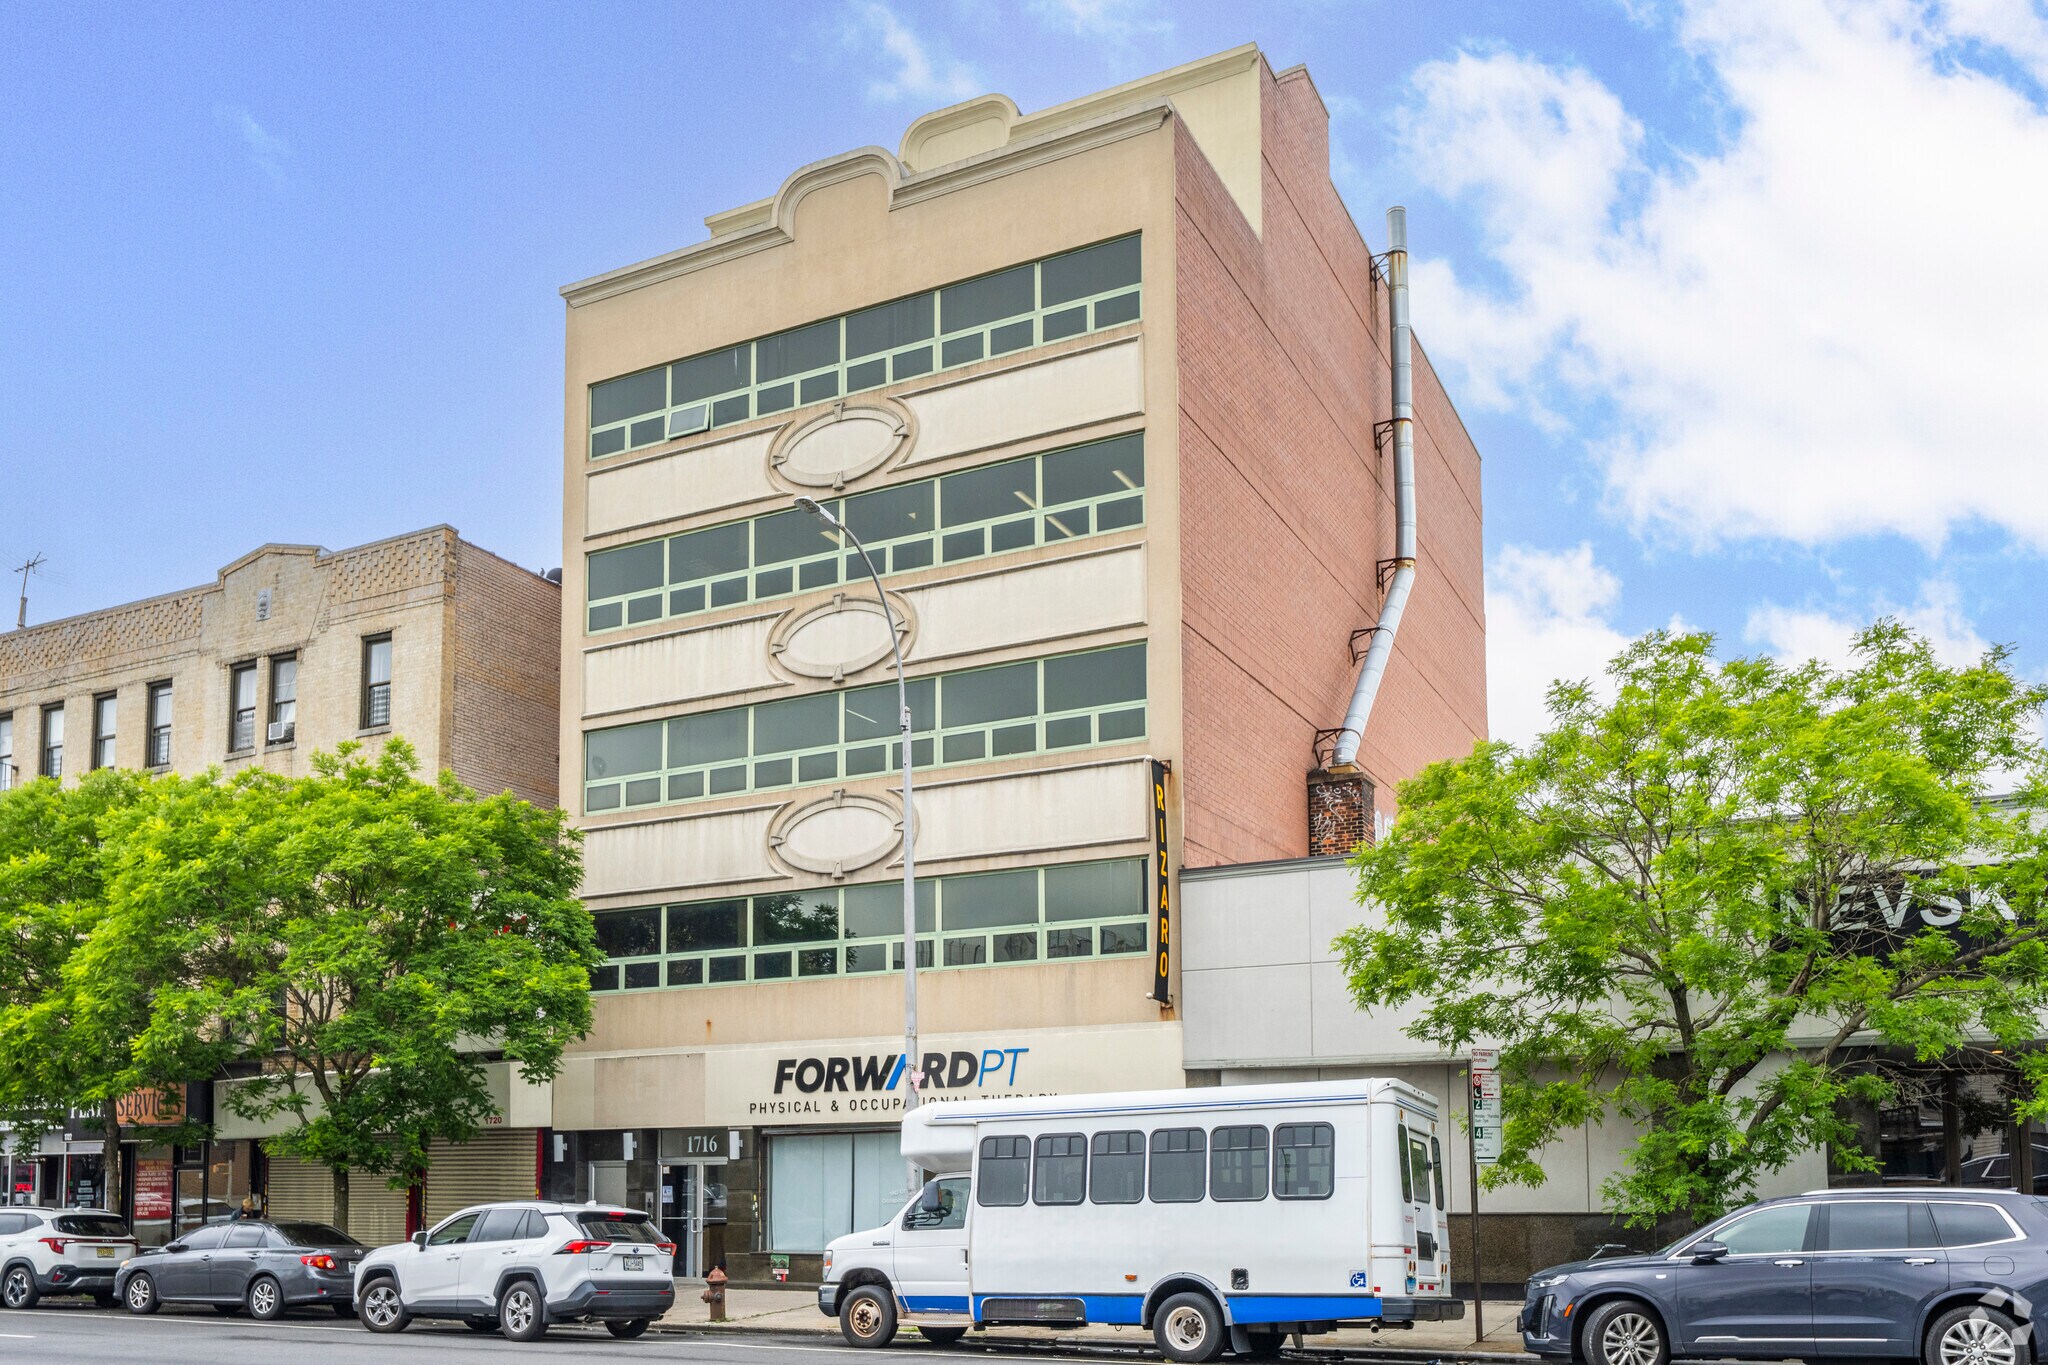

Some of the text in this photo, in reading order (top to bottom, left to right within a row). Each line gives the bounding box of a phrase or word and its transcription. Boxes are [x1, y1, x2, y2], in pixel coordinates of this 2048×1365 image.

[1155, 783, 1169, 978] RIZARO
[1779, 878, 2042, 933] NEVSK
[118, 1092, 181, 1117] SERVICS
[749, 1099, 821, 1115] PHYSICAL
[830, 1099, 840, 1112] &
[849, 1094, 969, 1112] OCCUPIO
[485, 1116, 503, 1125] 1720
[1476, 1128, 1481, 1138] 4
[687, 1135, 718, 1153] 1716
[15, 1183, 33, 1192] OPEN
